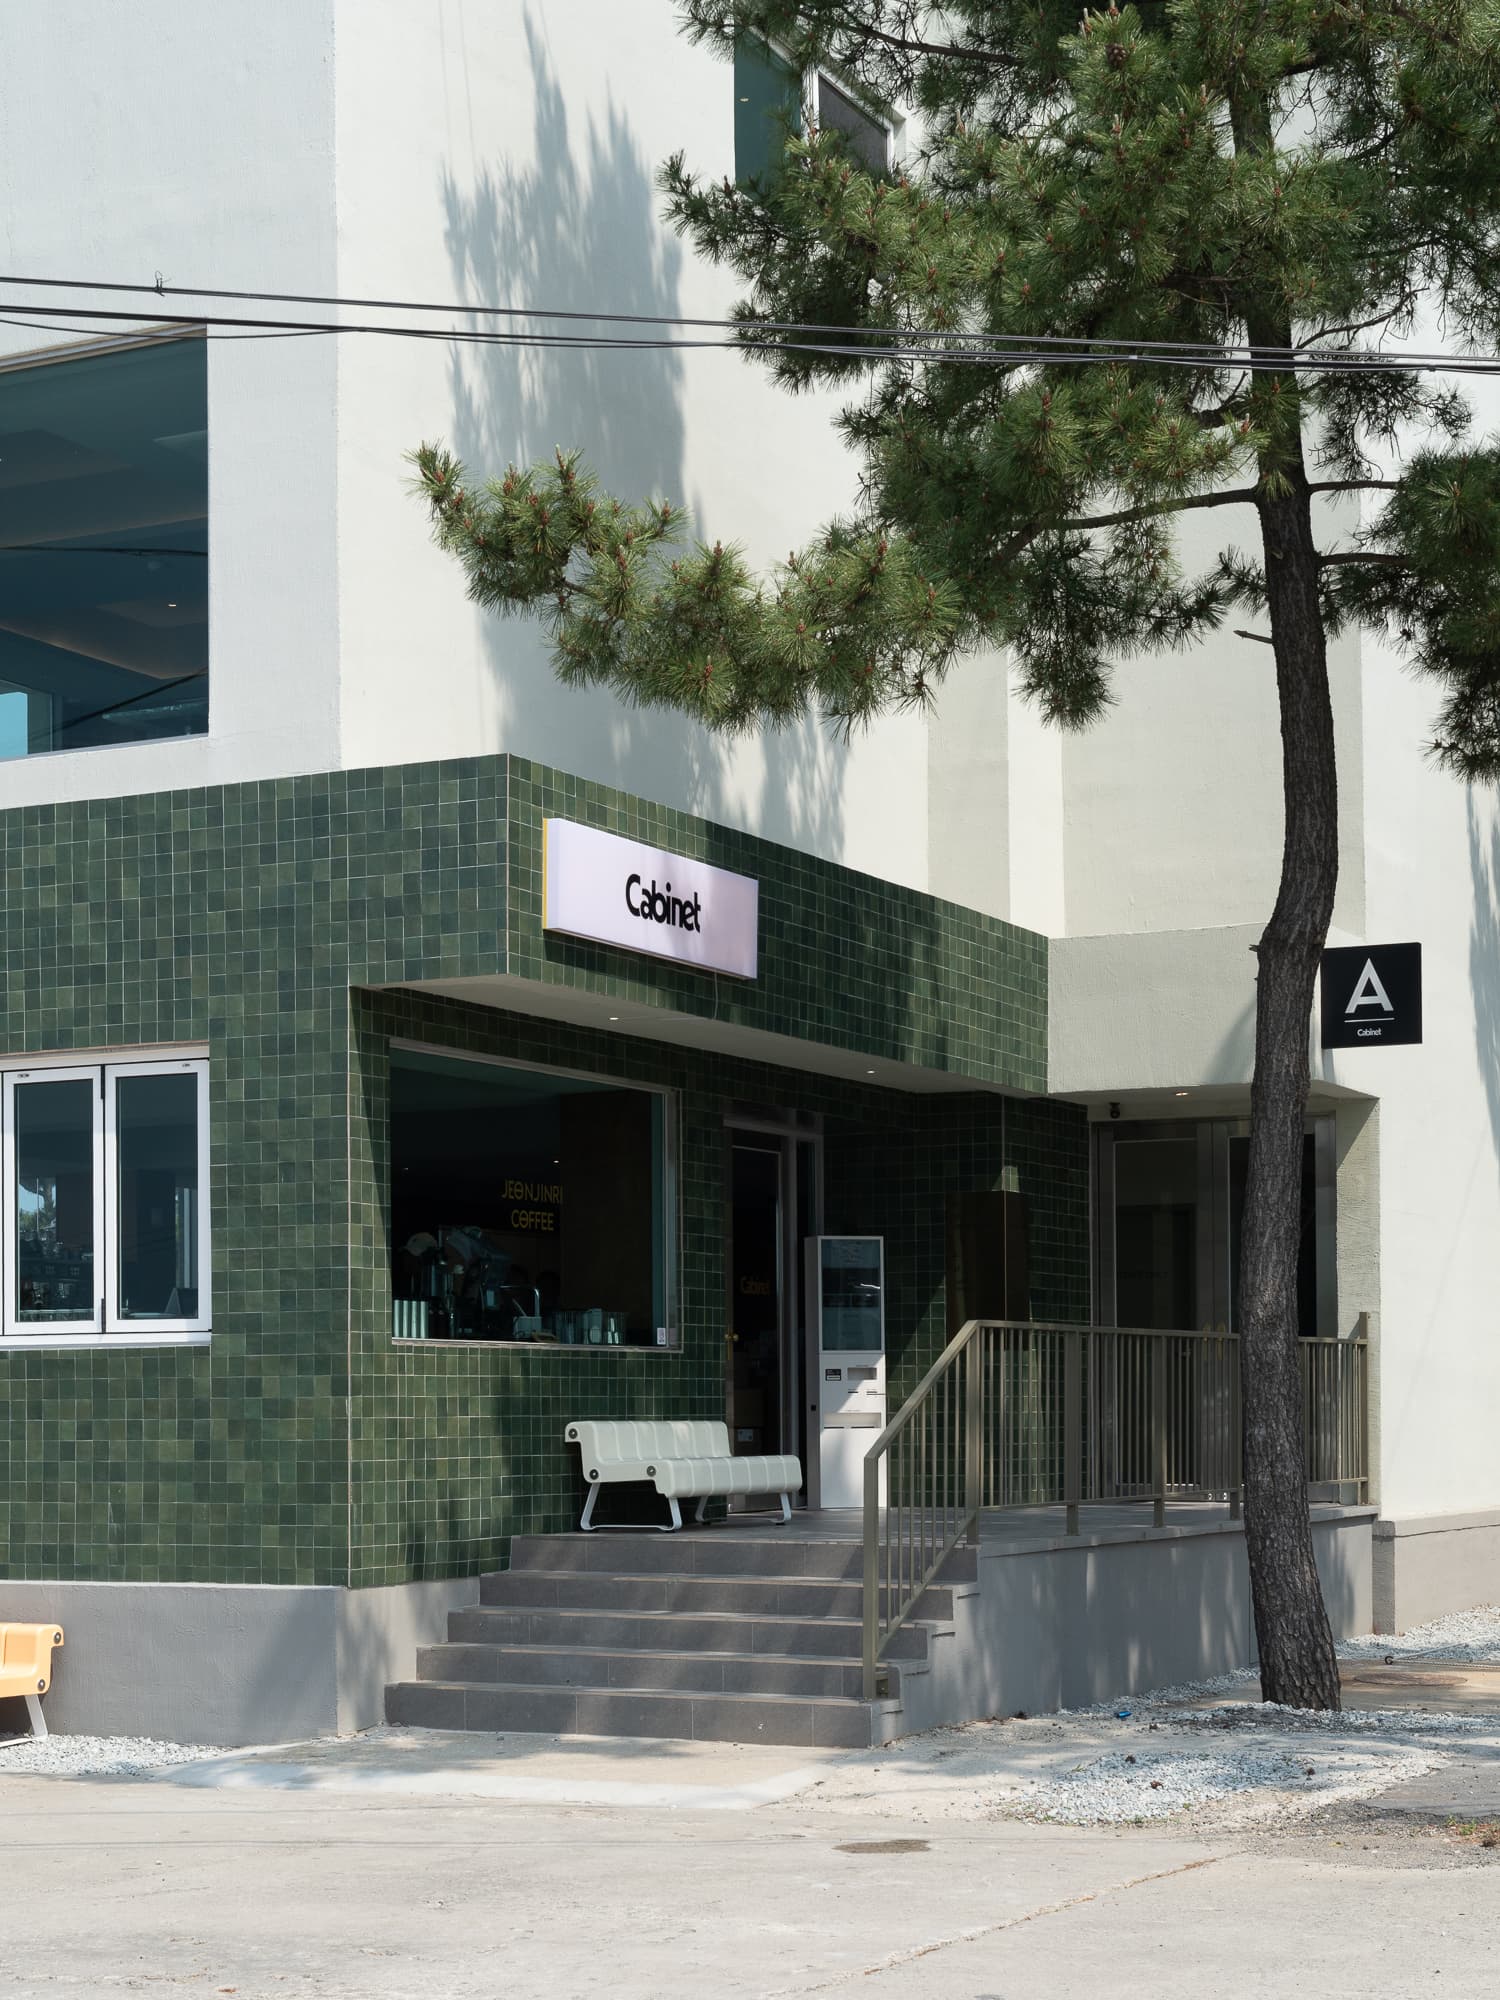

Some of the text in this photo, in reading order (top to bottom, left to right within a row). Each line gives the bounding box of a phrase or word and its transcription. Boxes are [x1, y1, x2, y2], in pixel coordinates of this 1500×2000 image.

[625, 873, 701, 933] Cabinet
[1344, 957, 1394, 1014] A
[1356, 1027, 1382, 1037] Cabinet
[511, 1208, 555, 1231] COFFEE
